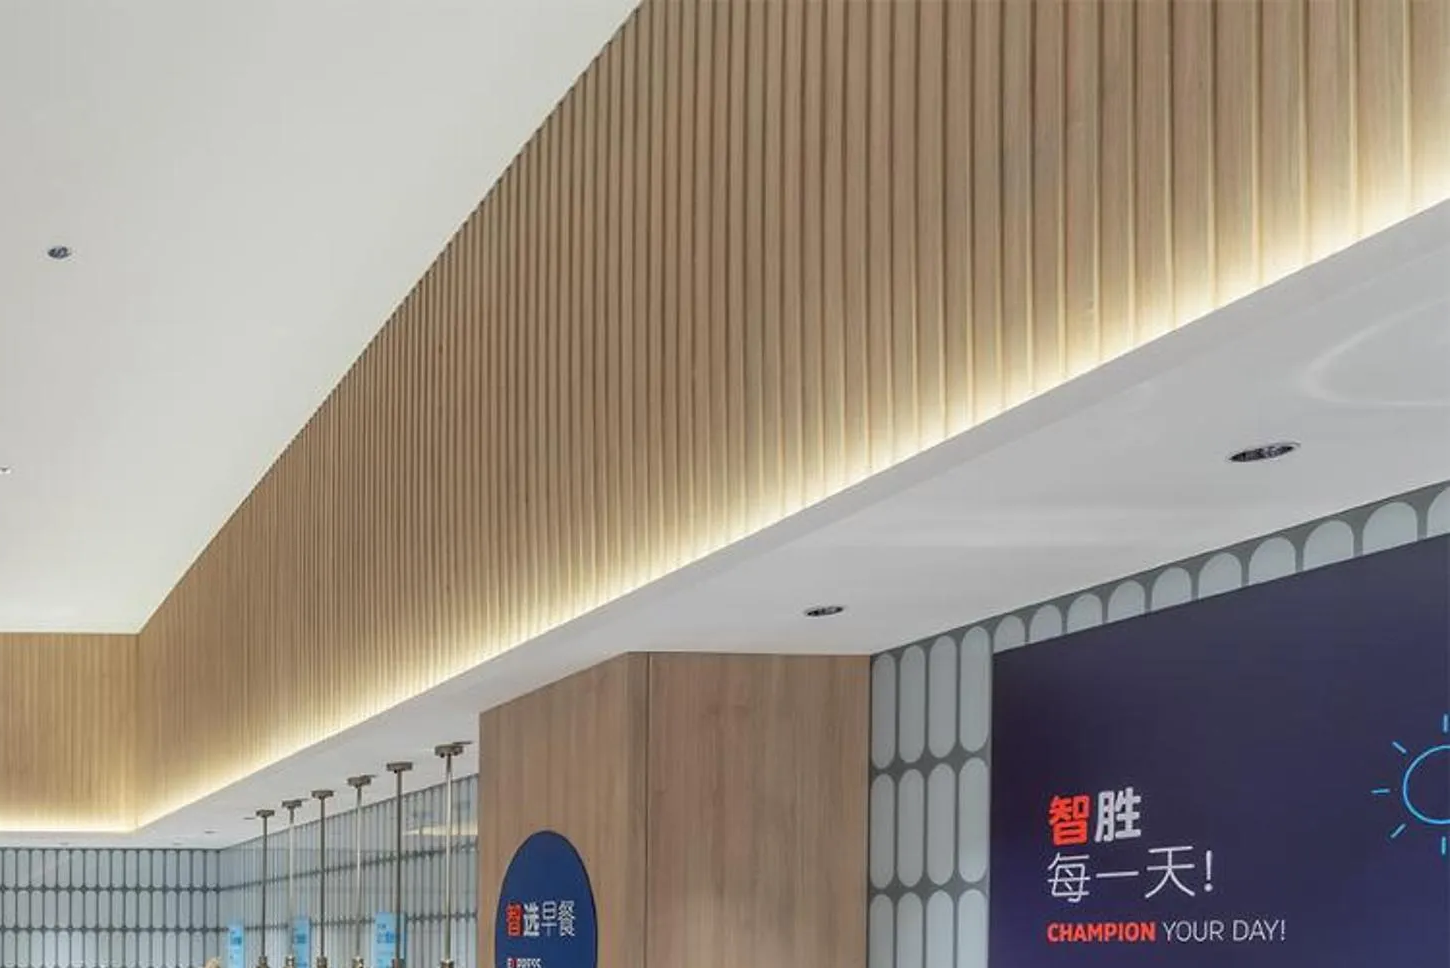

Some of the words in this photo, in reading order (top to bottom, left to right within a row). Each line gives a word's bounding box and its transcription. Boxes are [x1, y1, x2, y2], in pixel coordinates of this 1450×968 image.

[1047, 786, 1142, 846] 智胜
[506, 900, 576, 937] 智选早餐
[1046, 920, 1157, 944] CHAMPION
[1162, 919, 1225, 942] YOUR
[1232, 918, 1287, 942] DAY!
